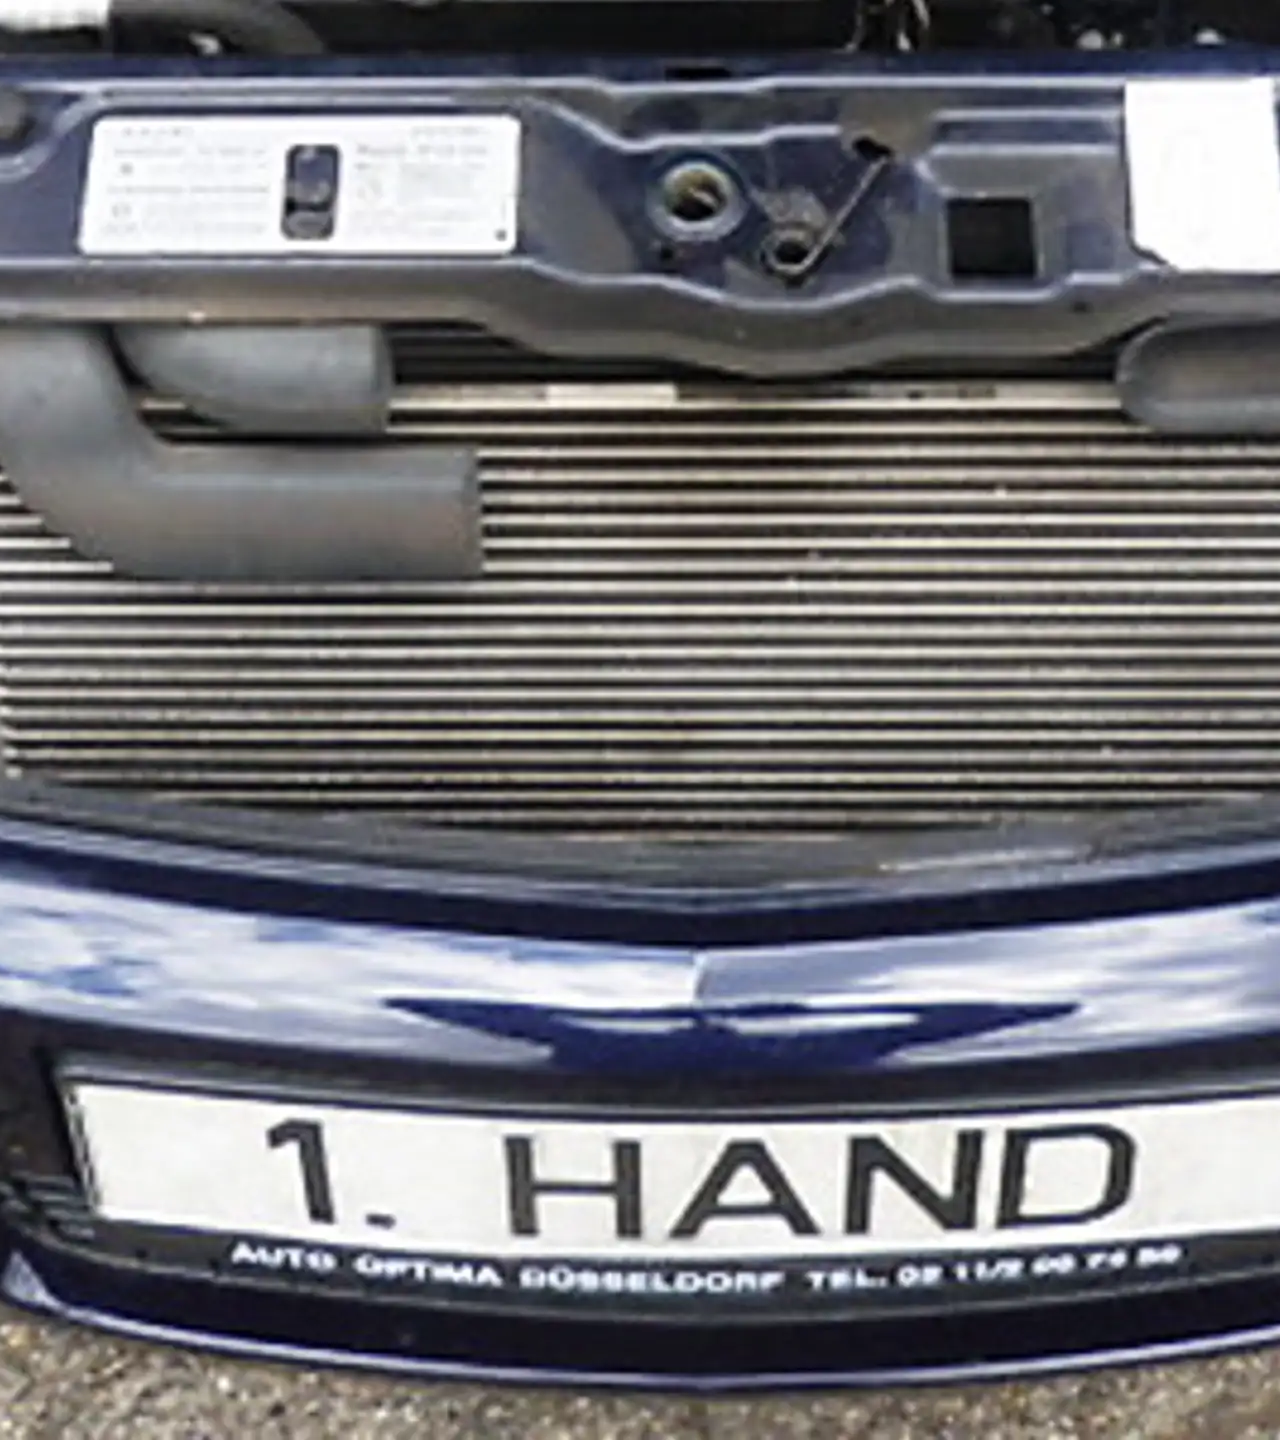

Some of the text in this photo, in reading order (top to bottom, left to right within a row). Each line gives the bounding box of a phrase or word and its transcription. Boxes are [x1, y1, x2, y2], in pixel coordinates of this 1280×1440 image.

[266, 1117, 1139, 1242] 1. HAND
[231, 1240, 337, 1275] AUTO
[352, 1252, 505, 1289] OPTIMA
